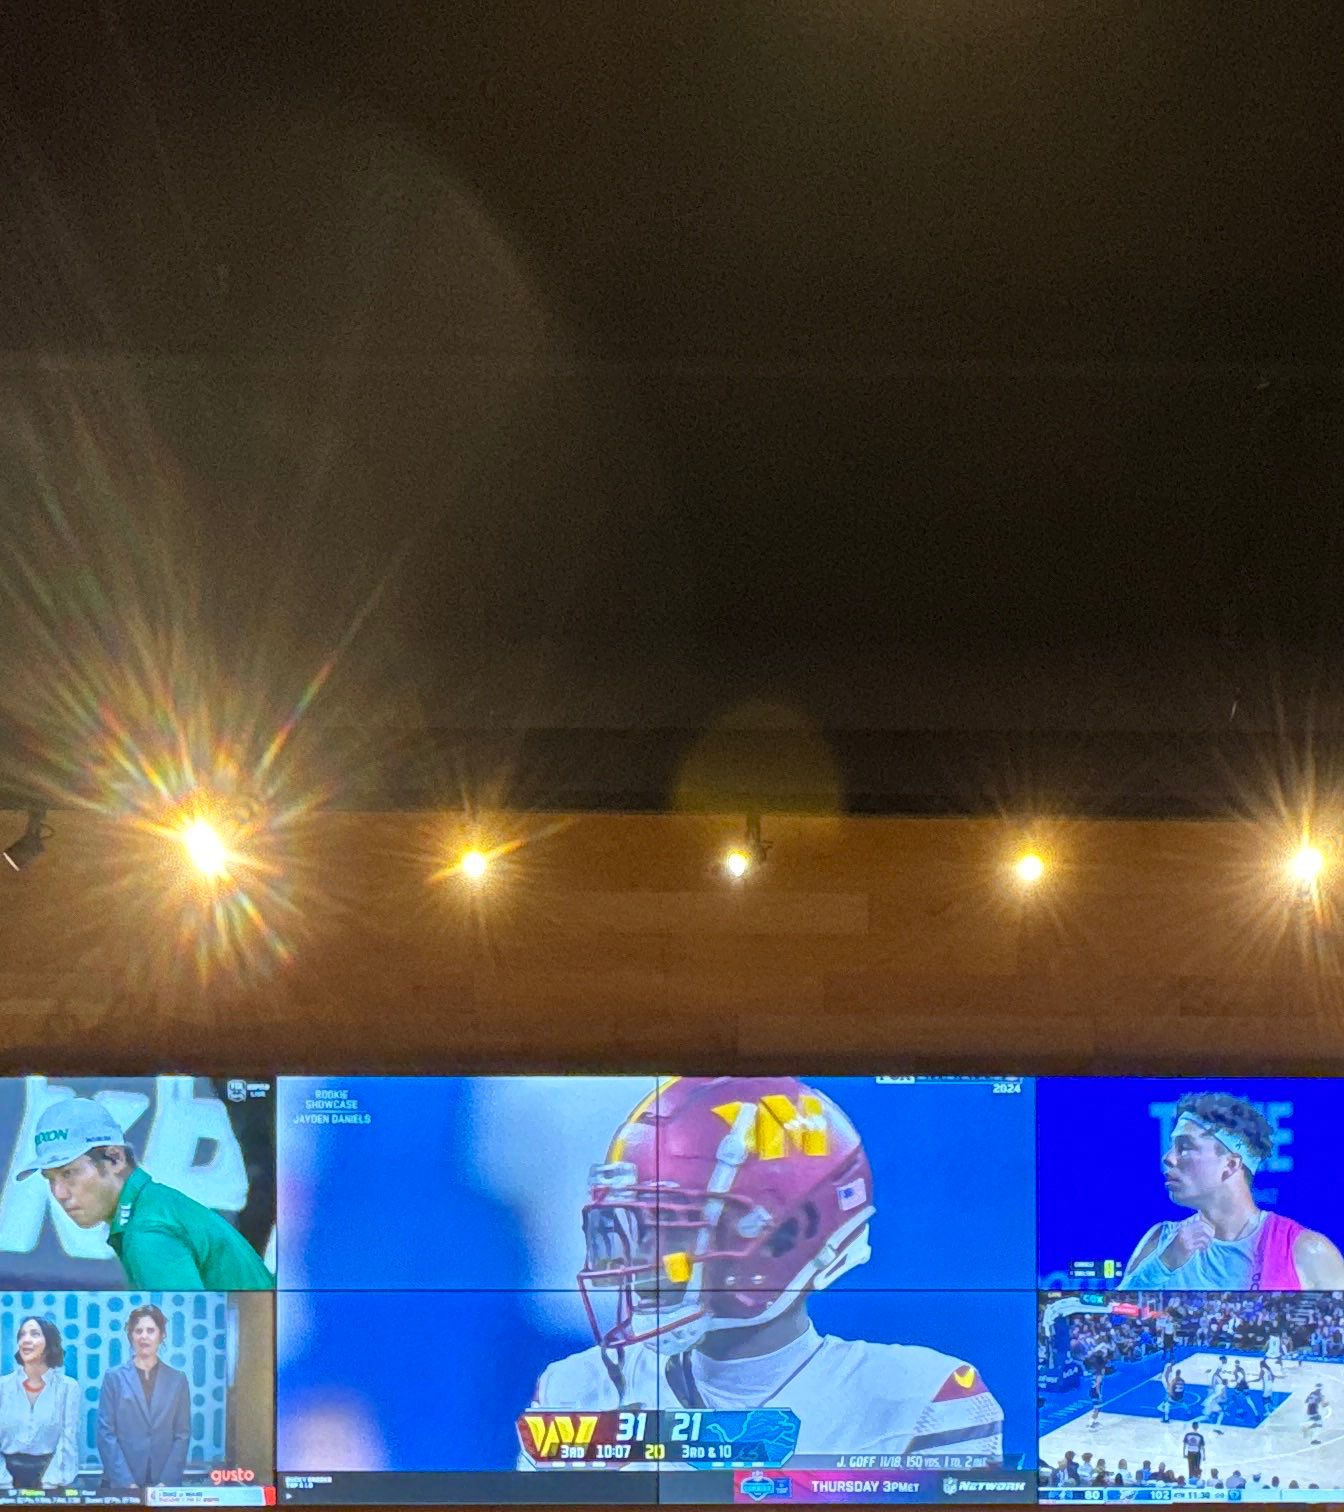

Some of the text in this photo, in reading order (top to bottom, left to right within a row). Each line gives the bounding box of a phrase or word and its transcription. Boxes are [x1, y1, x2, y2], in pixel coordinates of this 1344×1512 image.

[992, 1083, 1022, 1094] 2024
[314, 1089, 349, 1100] ROOKIE
[305, 1100, 358, 1109] SHOWCASE
[294, 1113, 372, 1124] JAYDEN DANIELS
[616, 1412, 702, 1441] 31 21
[560, 1443, 732, 1460] 3RD 10:07 20 3RD & 10
[849, 1455, 876, 1468] GOFF
[906, 1455, 923, 1468] 150
[964, 1455, 973, 1468] 2
[211, 1468, 255, 1485] gusto
[811, 1480, 879, 1493] THURSDAY
[958, 1481, 1025, 1491] NETWORK
[1150, 1489, 1171, 1500] 102
